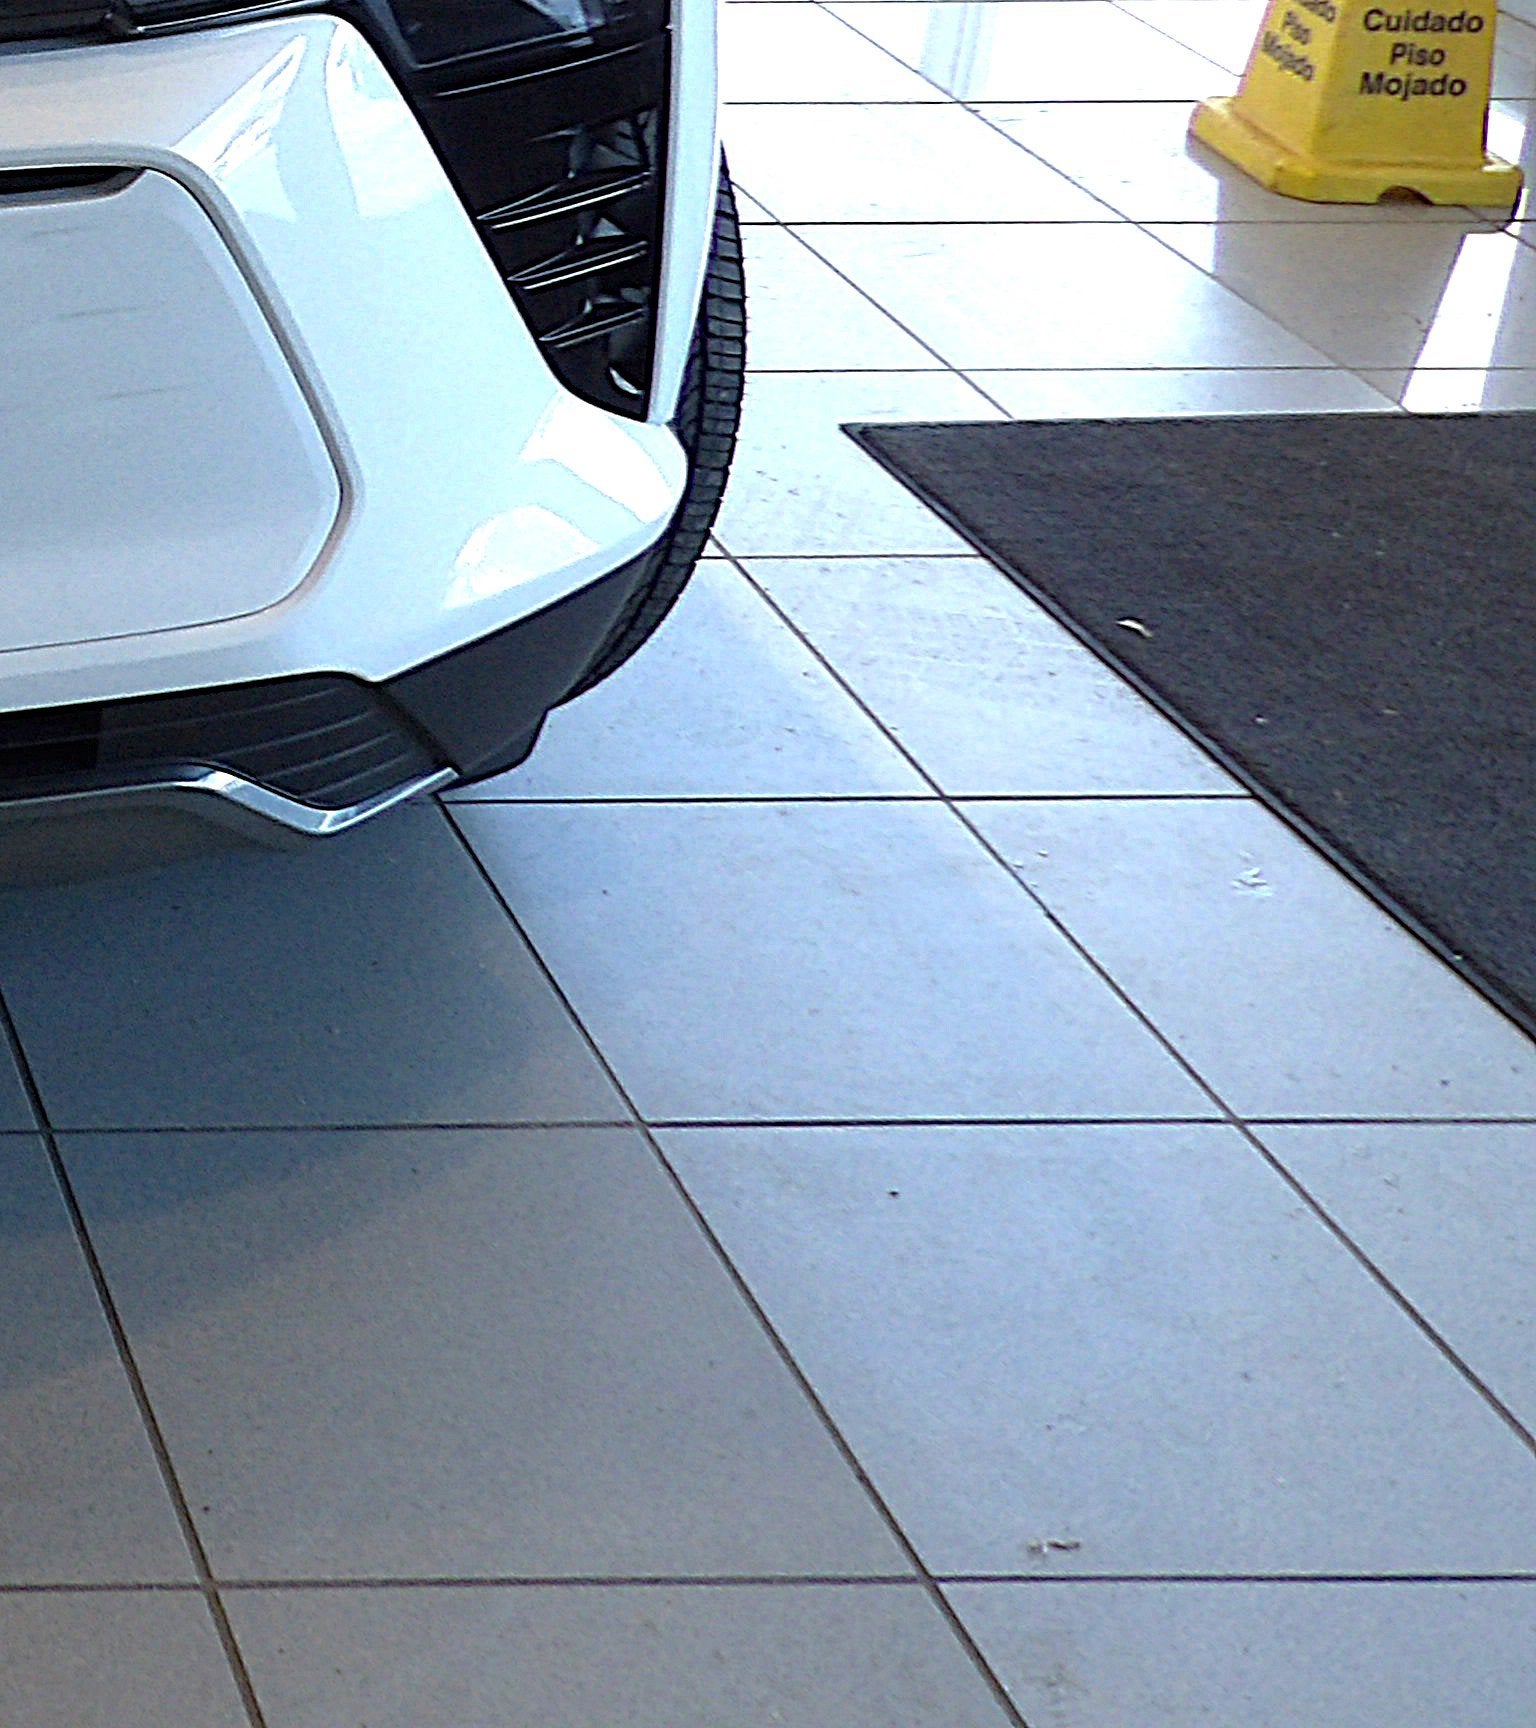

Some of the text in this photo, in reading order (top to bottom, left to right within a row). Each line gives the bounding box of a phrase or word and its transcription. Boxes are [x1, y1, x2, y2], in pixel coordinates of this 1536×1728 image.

[1363, 8, 1485, 34] Cuidado
[1389, 42, 1447, 66] Piso
[1359, 72, 1468, 101] Mojado
